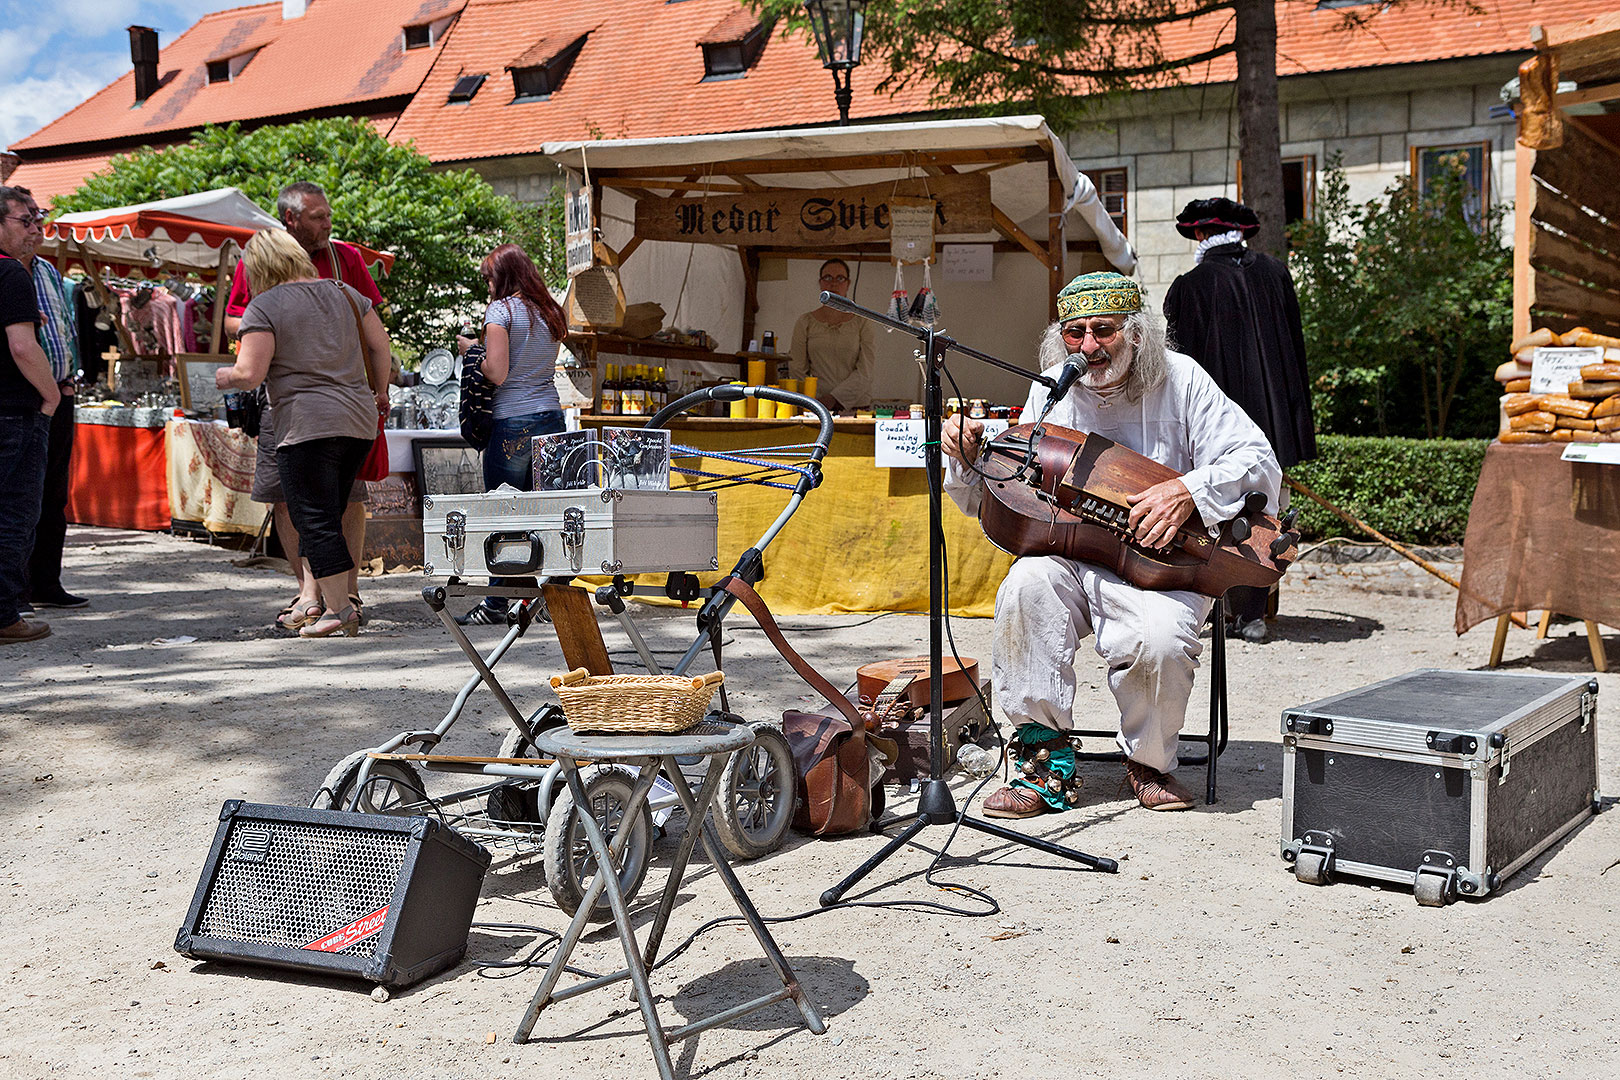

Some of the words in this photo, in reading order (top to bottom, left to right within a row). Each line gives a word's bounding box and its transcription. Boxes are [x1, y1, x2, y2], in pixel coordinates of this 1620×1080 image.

[675, 201, 781, 234] Medař
[886, 433, 918, 445] kouzelný
[232, 850, 265, 862] Roland
[343, 909, 388, 944] Street
